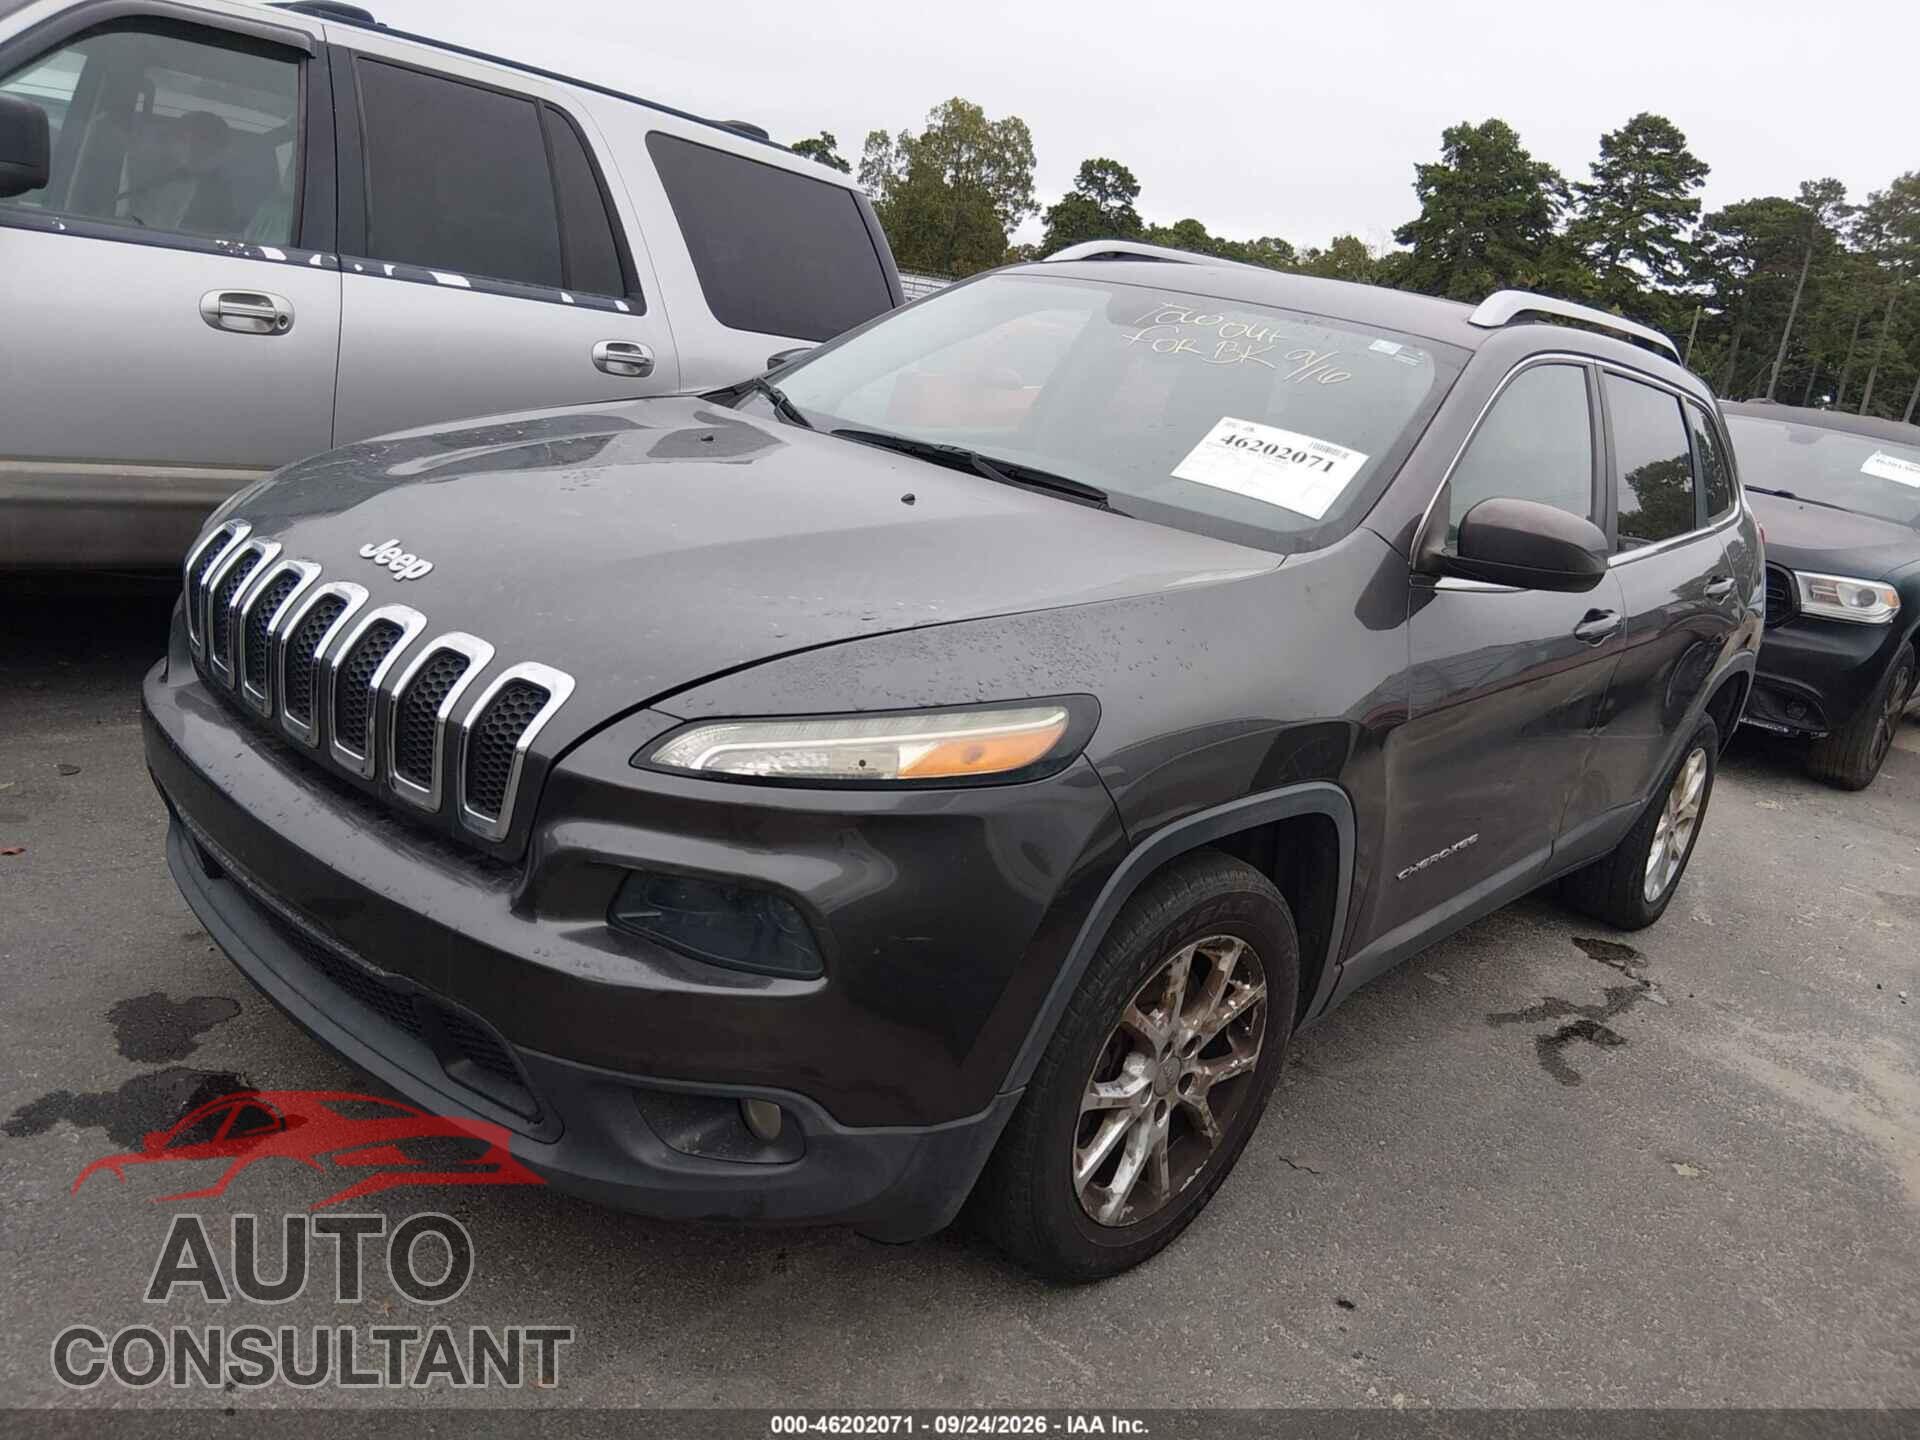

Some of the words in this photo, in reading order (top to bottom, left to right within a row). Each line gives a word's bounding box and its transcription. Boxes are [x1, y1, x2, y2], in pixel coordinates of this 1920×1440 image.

[1221, 434, 1336, 473] 46202071
[359, 538, 434, 581] Jeep
[1397, 833, 1480, 880] CHEROKEE
